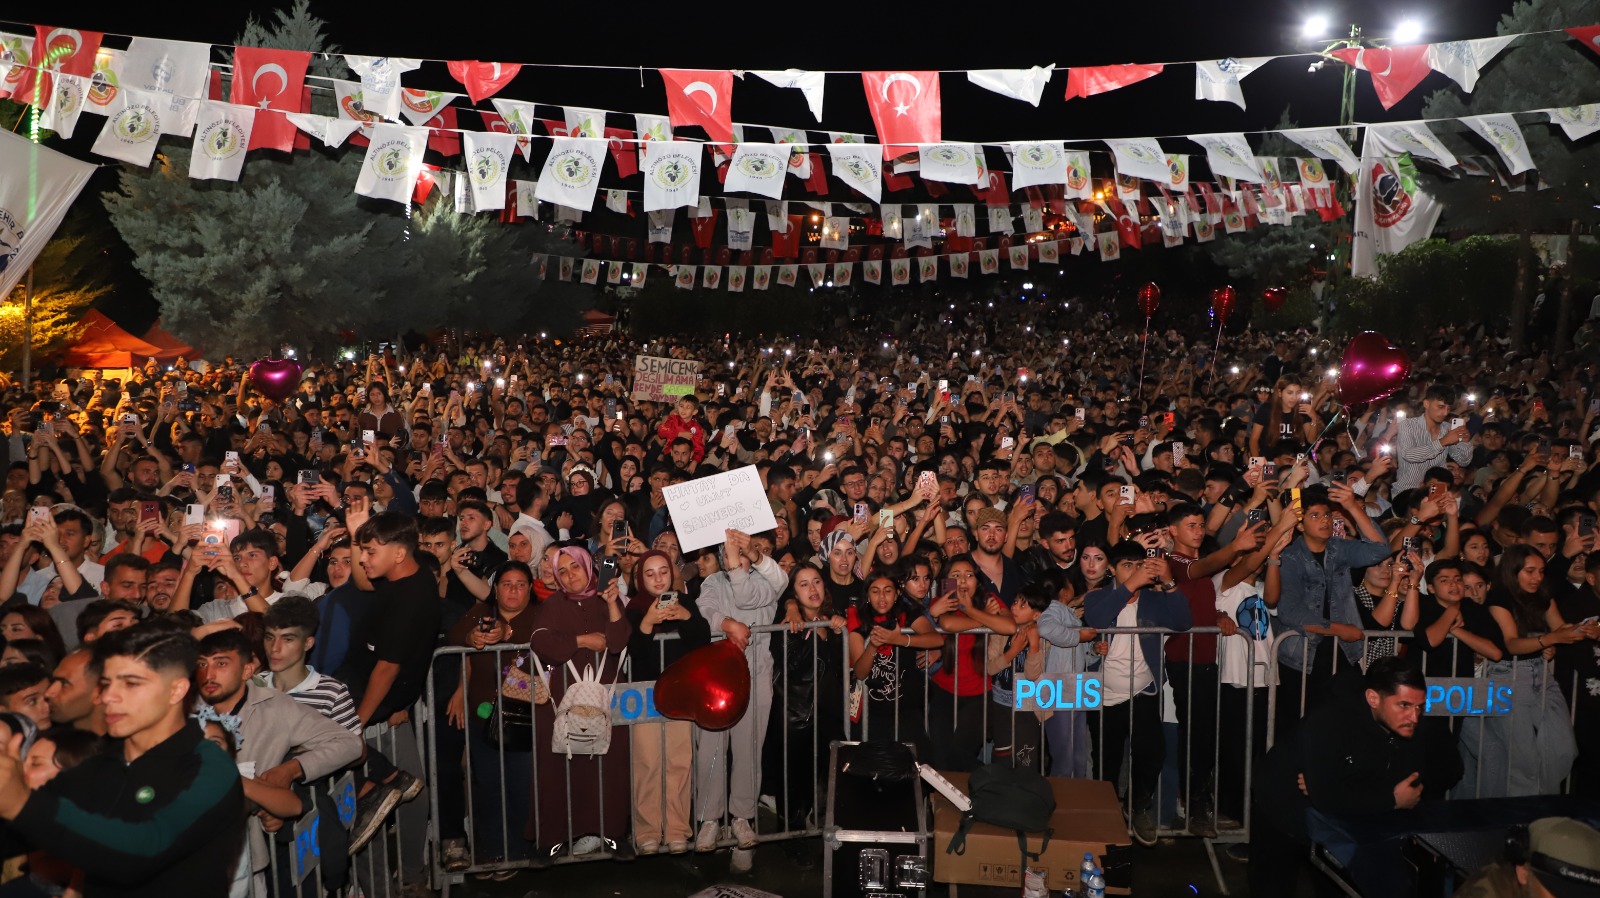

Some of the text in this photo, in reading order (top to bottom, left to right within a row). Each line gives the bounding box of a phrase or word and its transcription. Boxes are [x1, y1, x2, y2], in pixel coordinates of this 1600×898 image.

[638, 357, 698, 376] SEMİCENK
[633, 382, 662, 394] BENDE
[674, 375, 694, 385] AMA
[666, 471, 751, 502] HATAY DA
[727, 515, 755, 531] SEN
[1015, 673, 1101, 709] POLİS
[1424, 680, 1513, 715] POLİS
